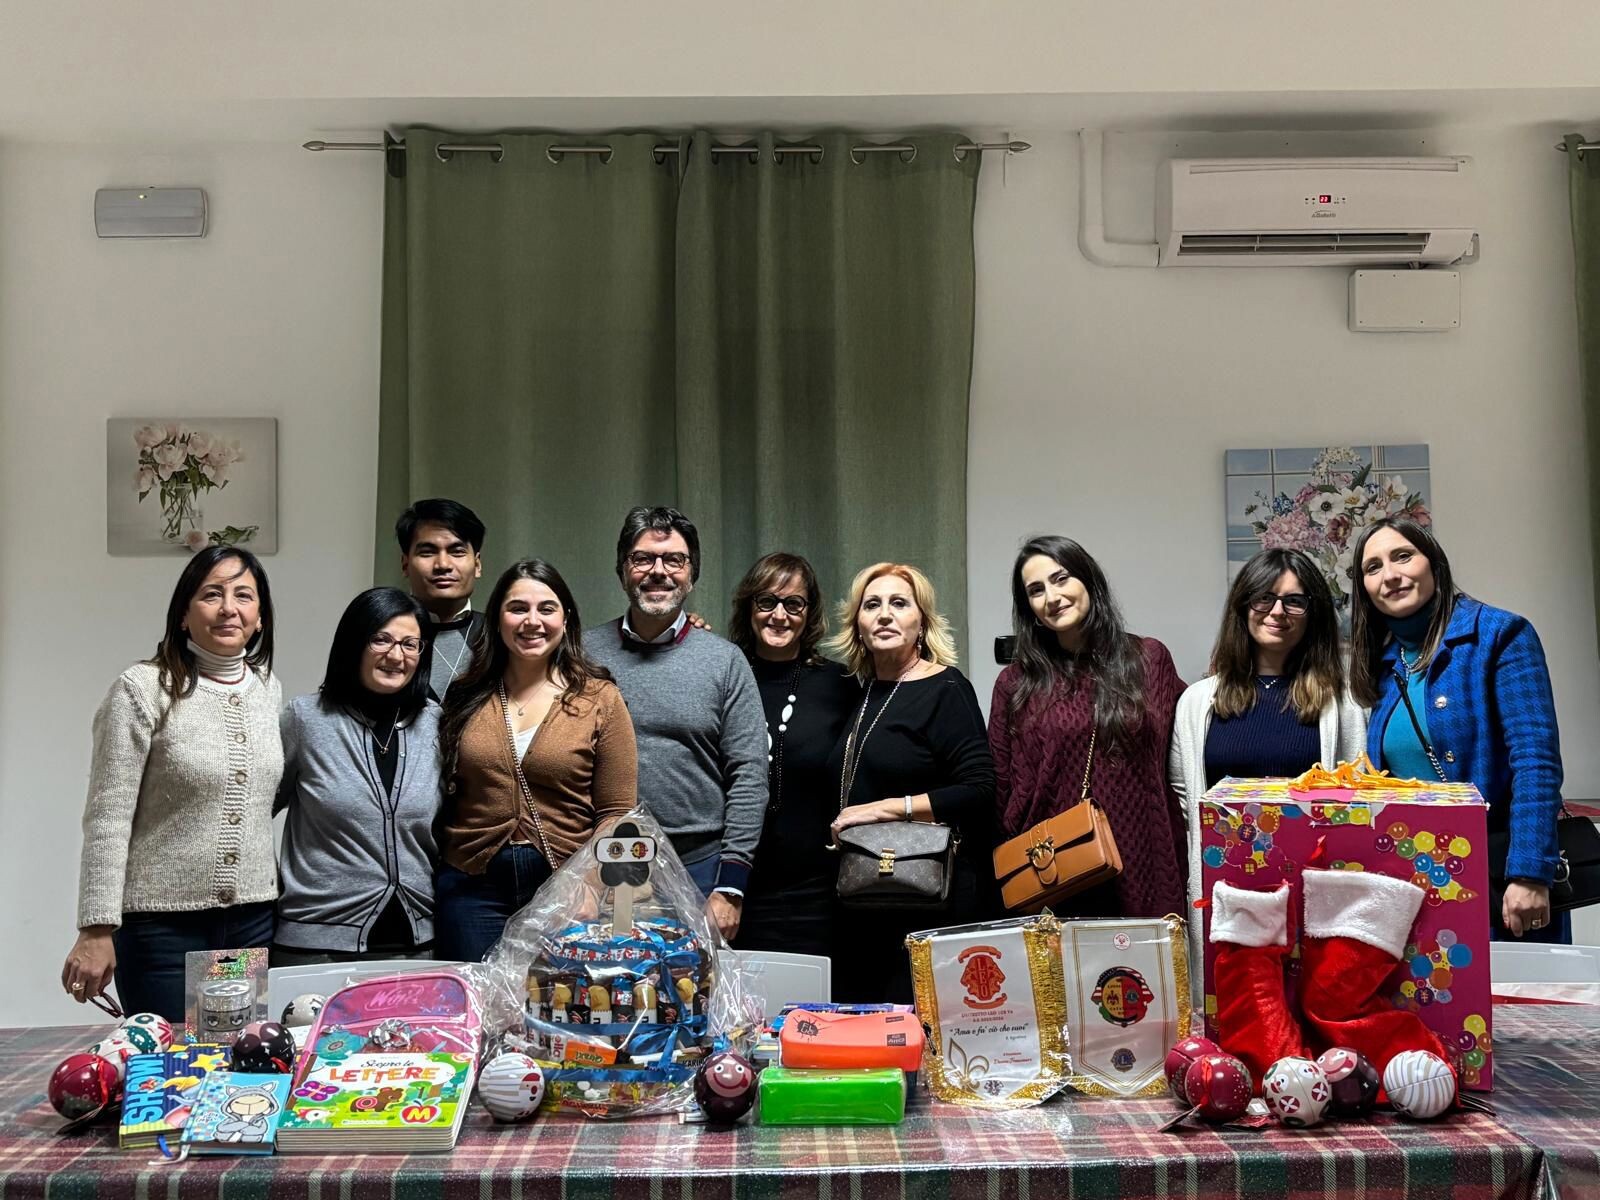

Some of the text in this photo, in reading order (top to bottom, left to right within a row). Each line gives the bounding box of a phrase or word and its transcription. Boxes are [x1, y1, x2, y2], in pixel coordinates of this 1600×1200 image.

[977, 958, 988, 997] LEO
[329, 1066, 440, 1084] LETTERE
[122, 1054, 165, 1126] SHOW!
[406, 1107, 431, 1120] M
